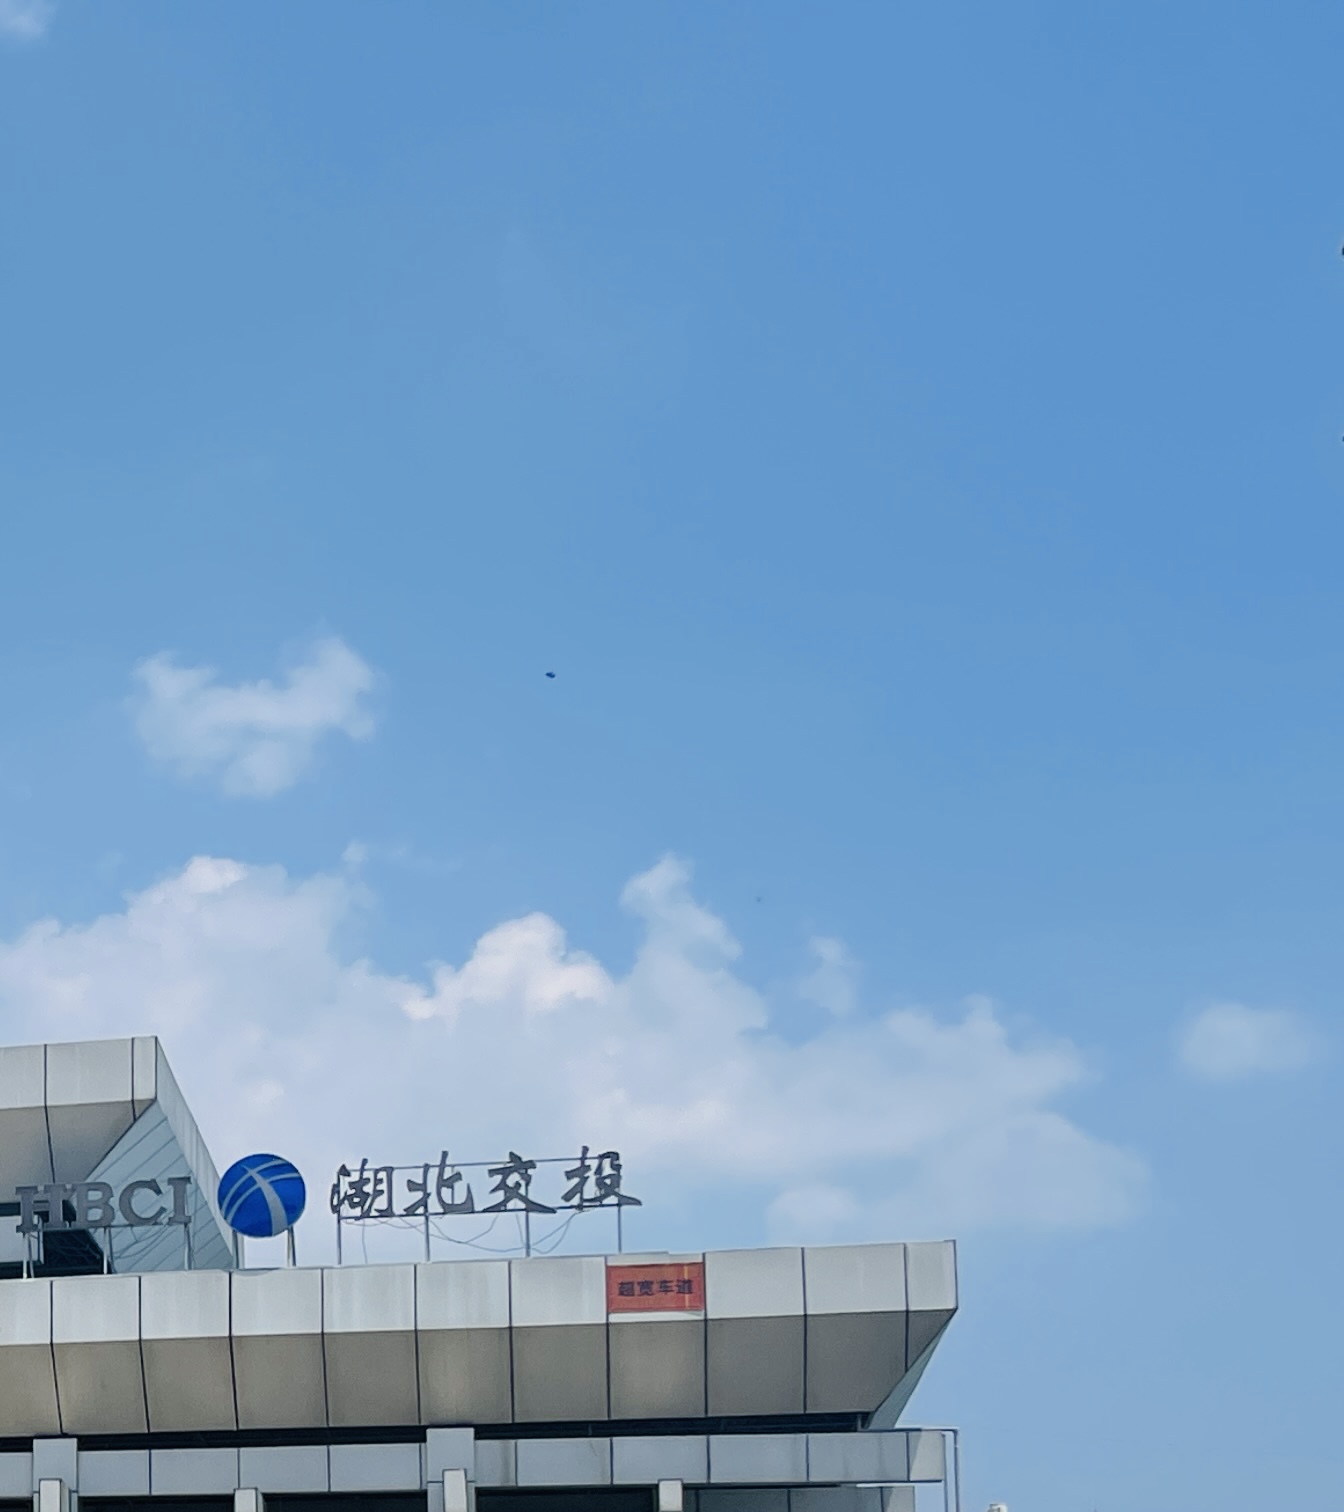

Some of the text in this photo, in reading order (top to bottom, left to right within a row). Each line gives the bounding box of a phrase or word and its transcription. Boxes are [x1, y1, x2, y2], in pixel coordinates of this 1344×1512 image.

[15, 1176, 192, 1233] HBCI
[330, 1146, 642, 1220] 湖北交投
[618, 1279, 693, 1297] 超宽车道
